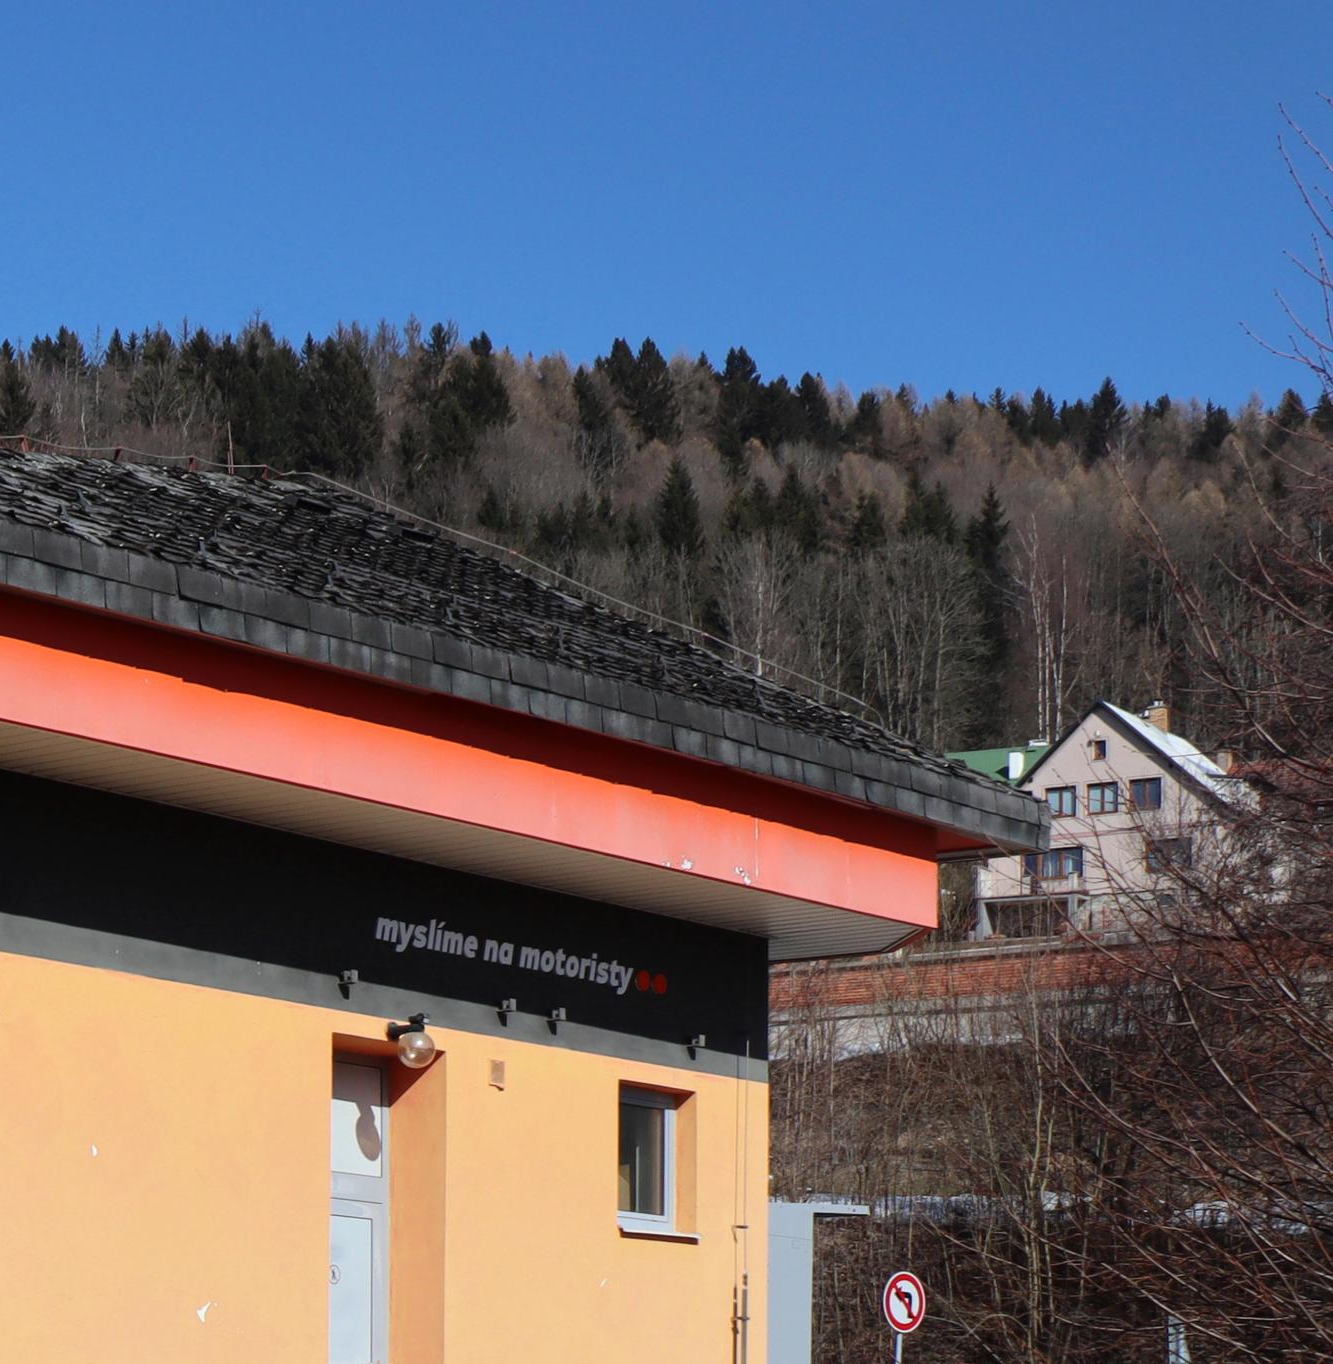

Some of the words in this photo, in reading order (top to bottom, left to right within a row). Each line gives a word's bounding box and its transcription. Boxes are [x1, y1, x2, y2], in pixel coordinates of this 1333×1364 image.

[374, 916, 479, 958] myslíme
[483, 938, 515, 966] na
[519, 946, 635, 995] motoristy
